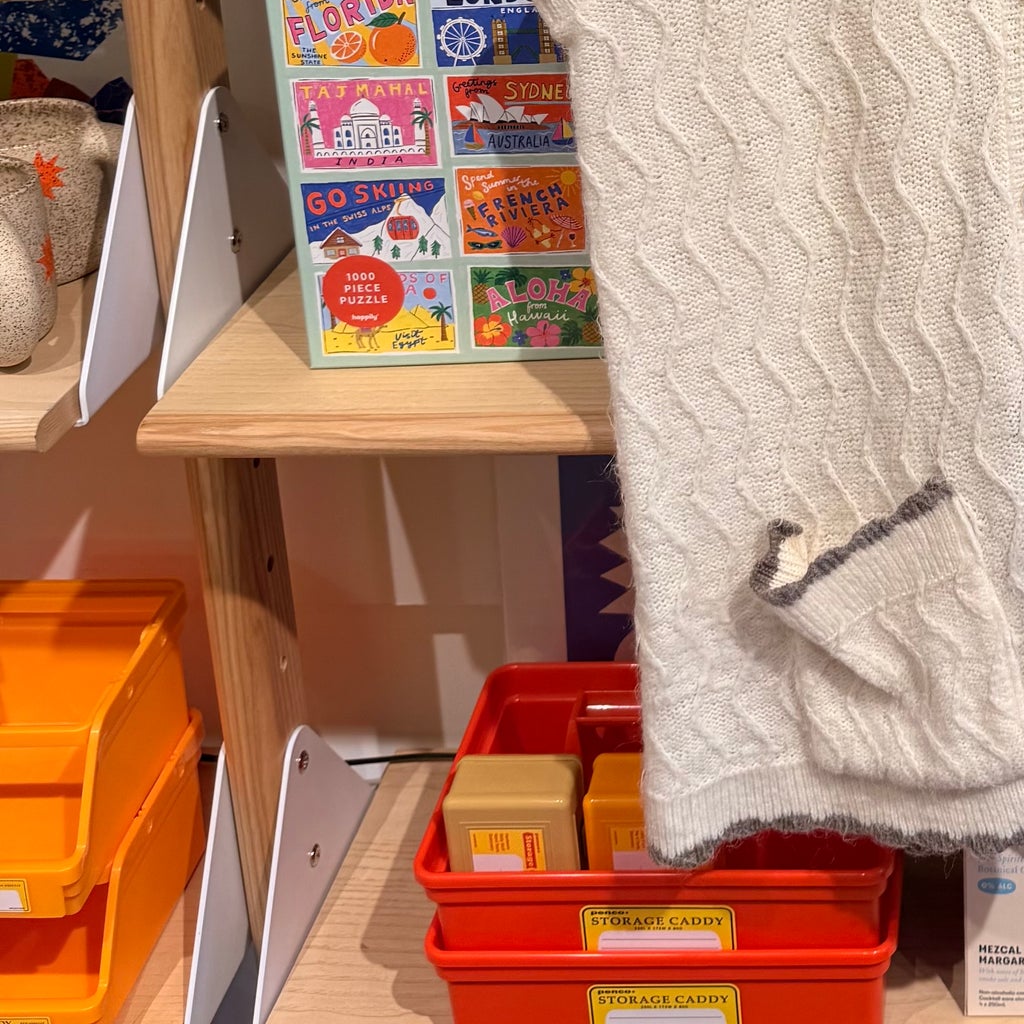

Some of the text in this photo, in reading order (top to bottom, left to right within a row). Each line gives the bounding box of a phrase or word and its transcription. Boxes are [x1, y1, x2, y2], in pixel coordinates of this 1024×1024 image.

[299, 83, 428, 99] TAJ MAHAL
[452, 78, 497, 93] Greetings
[504, 81, 571, 101] SYDNE
[487, 134, 550, 149] AUSTRALIA
[335, 156, 404, 166] INDIA
[461, 170, 495, 191] Spend
[480, 176, 521, 193] Summer
[306, 180, 434, 216] GO SKIING
[476, 183, 564, 219] FRENCH
[309, 203, 392, 232] IN THE SWISS ALPS
[486, 197, 569, 228] RIVIERA
[345, 272, 376, 281] 1000
[425, 273, 448, 284] OF
[343, 283, 381, 293] PIECE
[339, 294, 389, 305] PUZZLE
[485, 277, 592, 314] ALOHA
[526, 301, 548, 314] from
[351, 313, 379, 321] happily
[507, 309, 571, 327] Hawaii
[395, 329, 424, 341] Visit
[392, 337, 428, 350] Egypt
[525, 834, 535, 867] Storage
[998, 882, 1013, 890] ALC
[591, 916, 724, 926] STORAGE CADDY
[978, 944, 1022, 955] MEZCAL
[598, 995, 729, 1005] STORAGE CADDY
